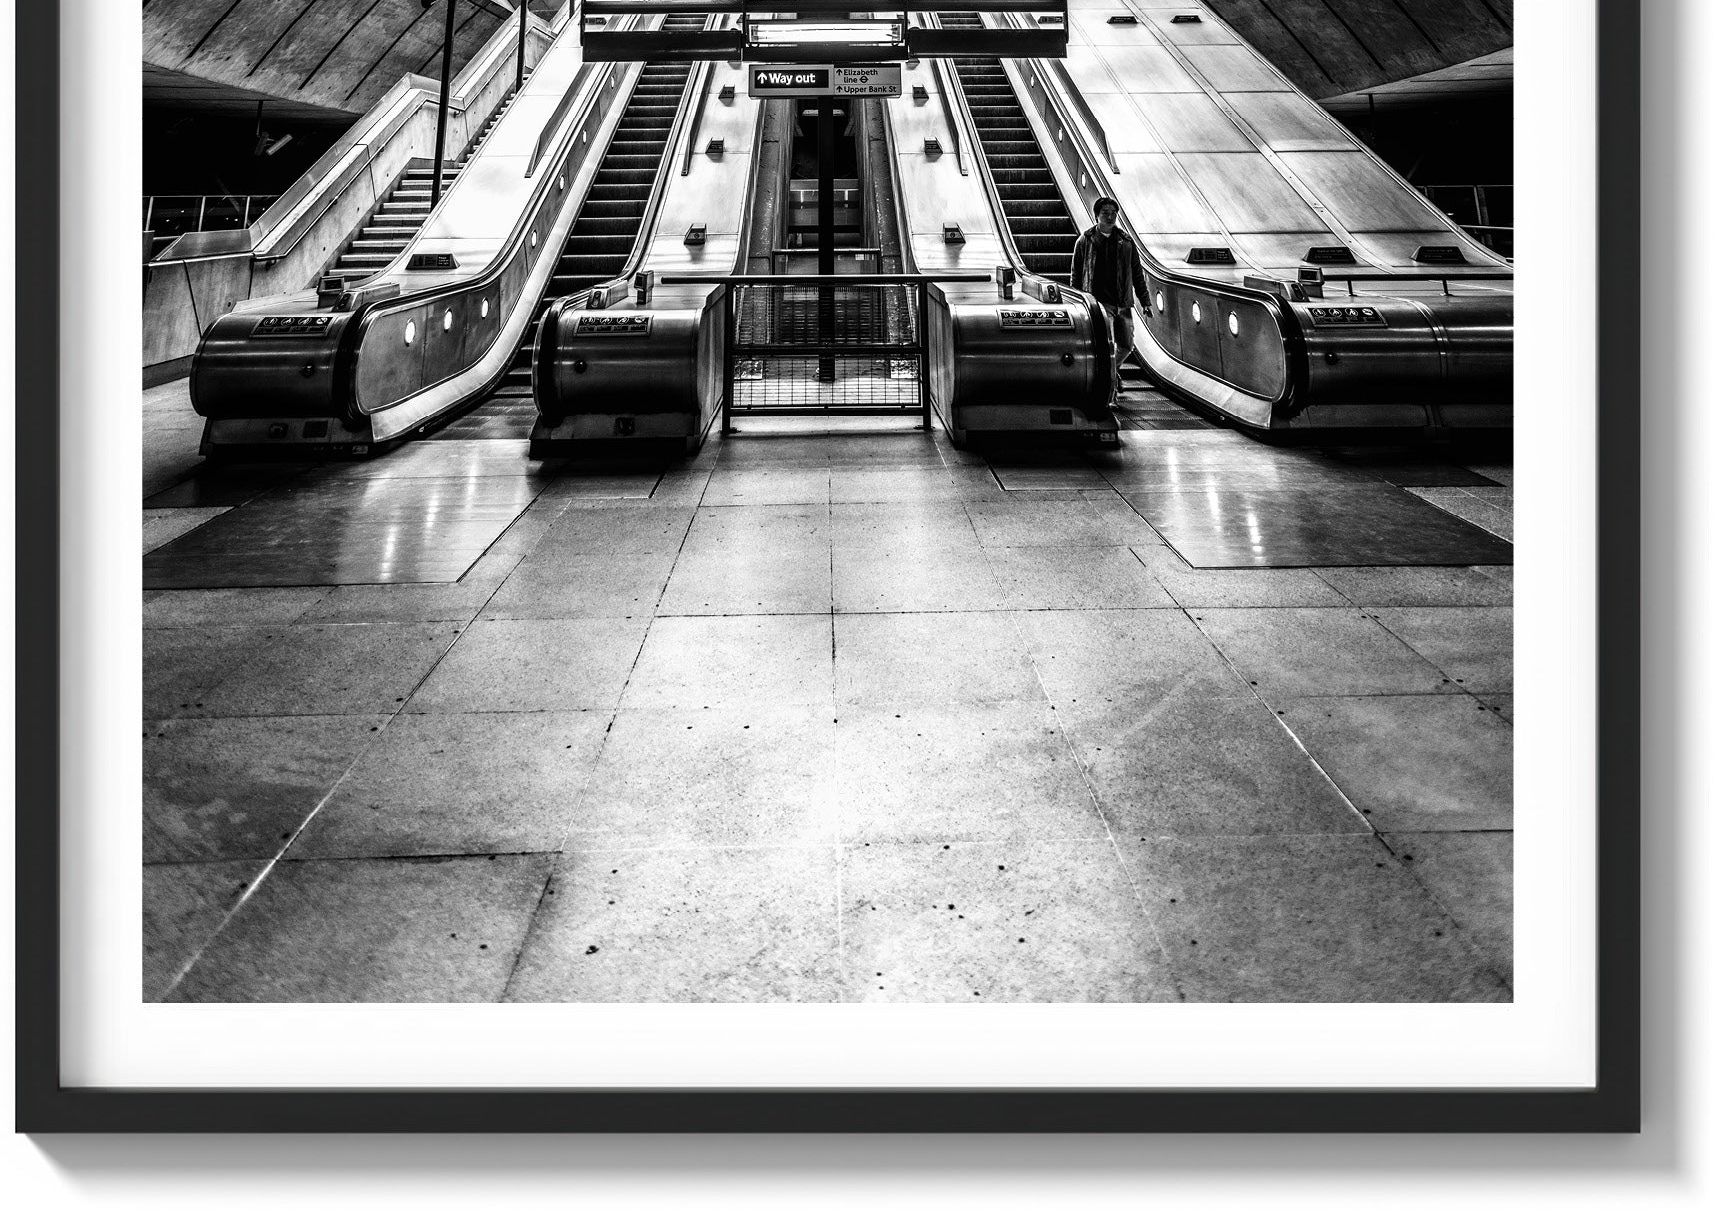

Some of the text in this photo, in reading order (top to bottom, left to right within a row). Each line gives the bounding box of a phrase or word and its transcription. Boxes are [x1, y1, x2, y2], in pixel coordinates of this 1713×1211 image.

[769, 73, 816, 85] Way out
[844, 86, 867, 94] Upper
